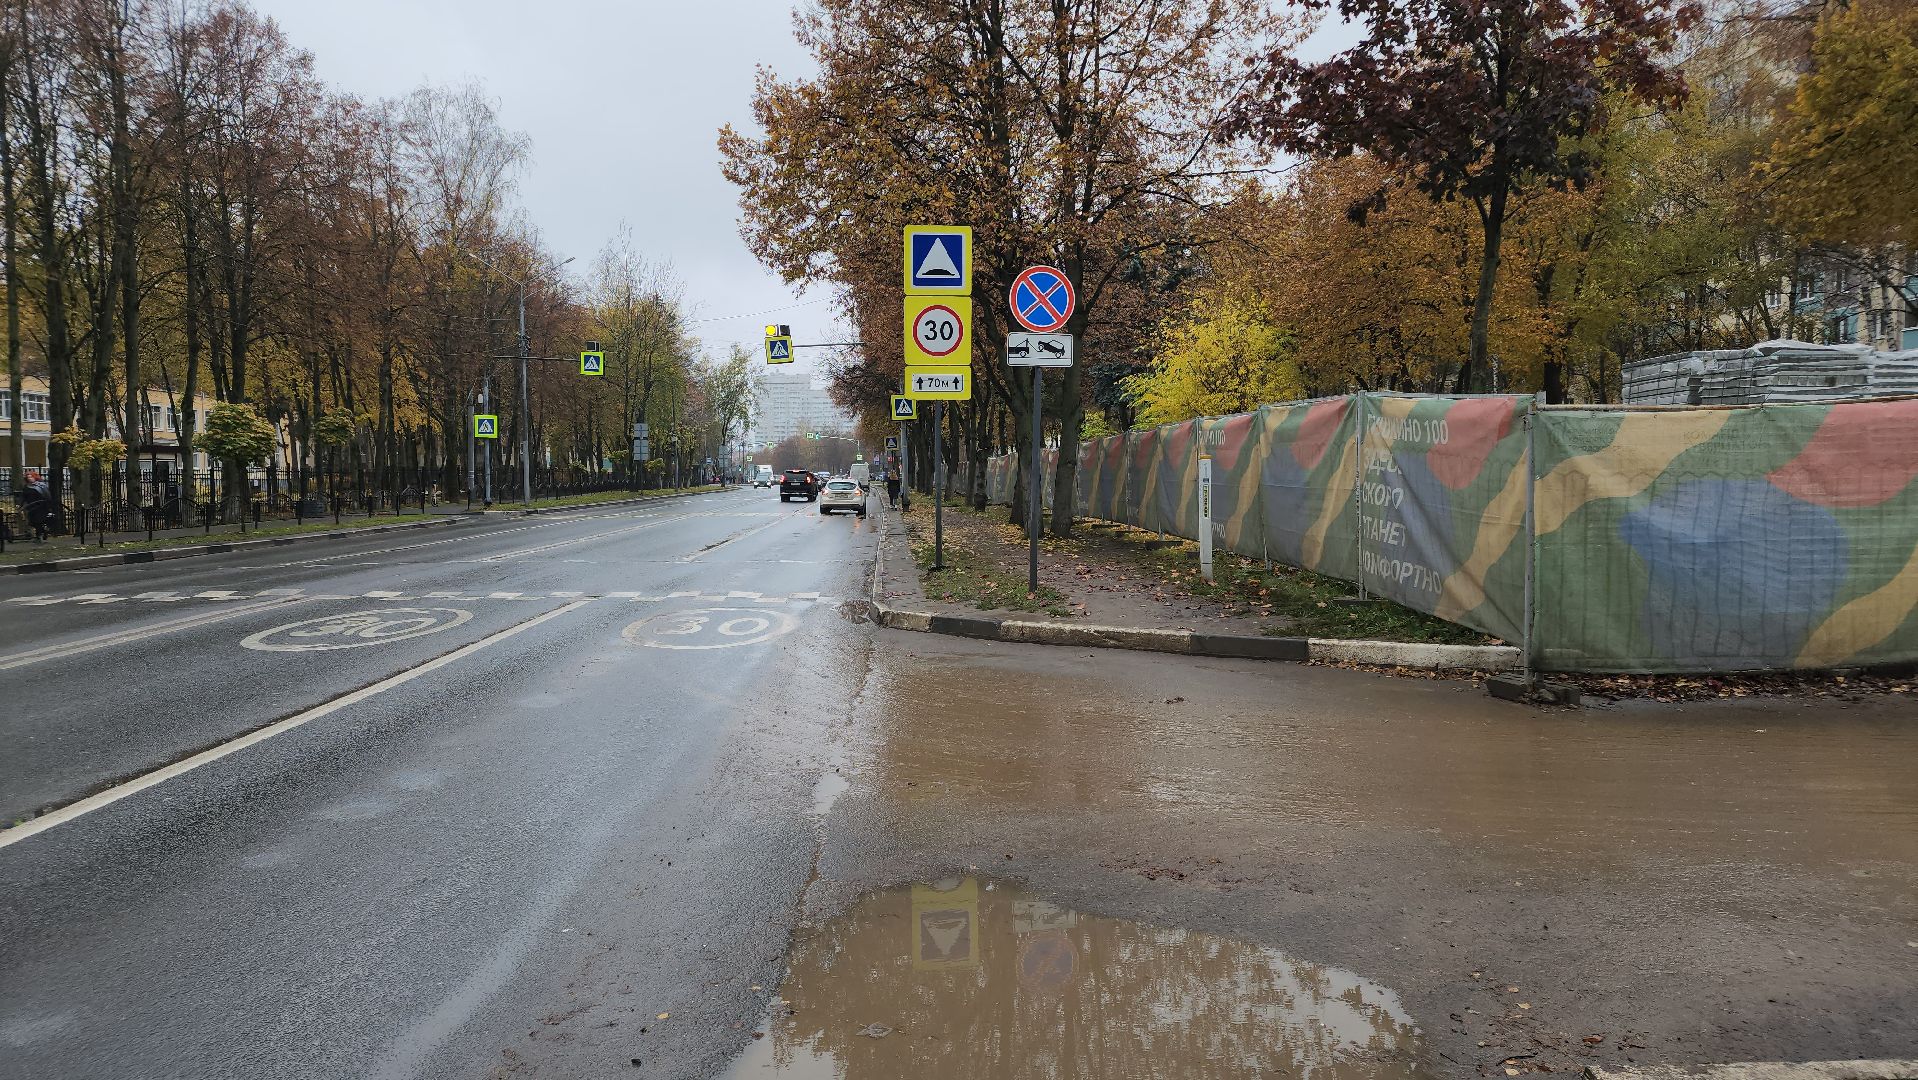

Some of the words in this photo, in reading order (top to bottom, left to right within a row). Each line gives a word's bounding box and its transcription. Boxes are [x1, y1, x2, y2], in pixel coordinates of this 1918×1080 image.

[924, 319, 954, 341] 30
[1424, 419, 1449, 445] 100
[1362, 550, 1441, 593] ОМФОРТНО
[652, 616, 770, 636] 30
